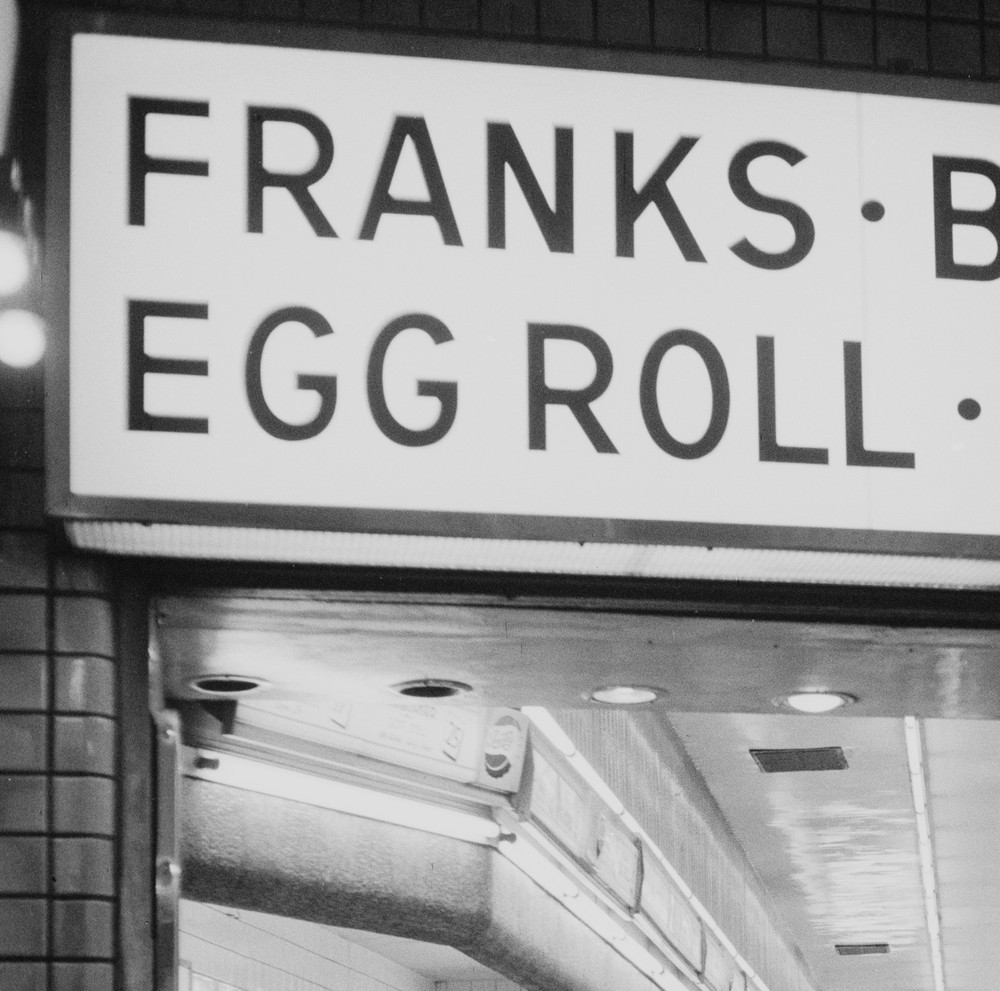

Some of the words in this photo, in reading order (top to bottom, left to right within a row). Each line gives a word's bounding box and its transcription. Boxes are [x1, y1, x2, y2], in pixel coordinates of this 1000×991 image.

[127, 95, 815, 270] FRANKS
[127, 299, 458, 447] EGG
[527, 323, 915, 469] ROLL
